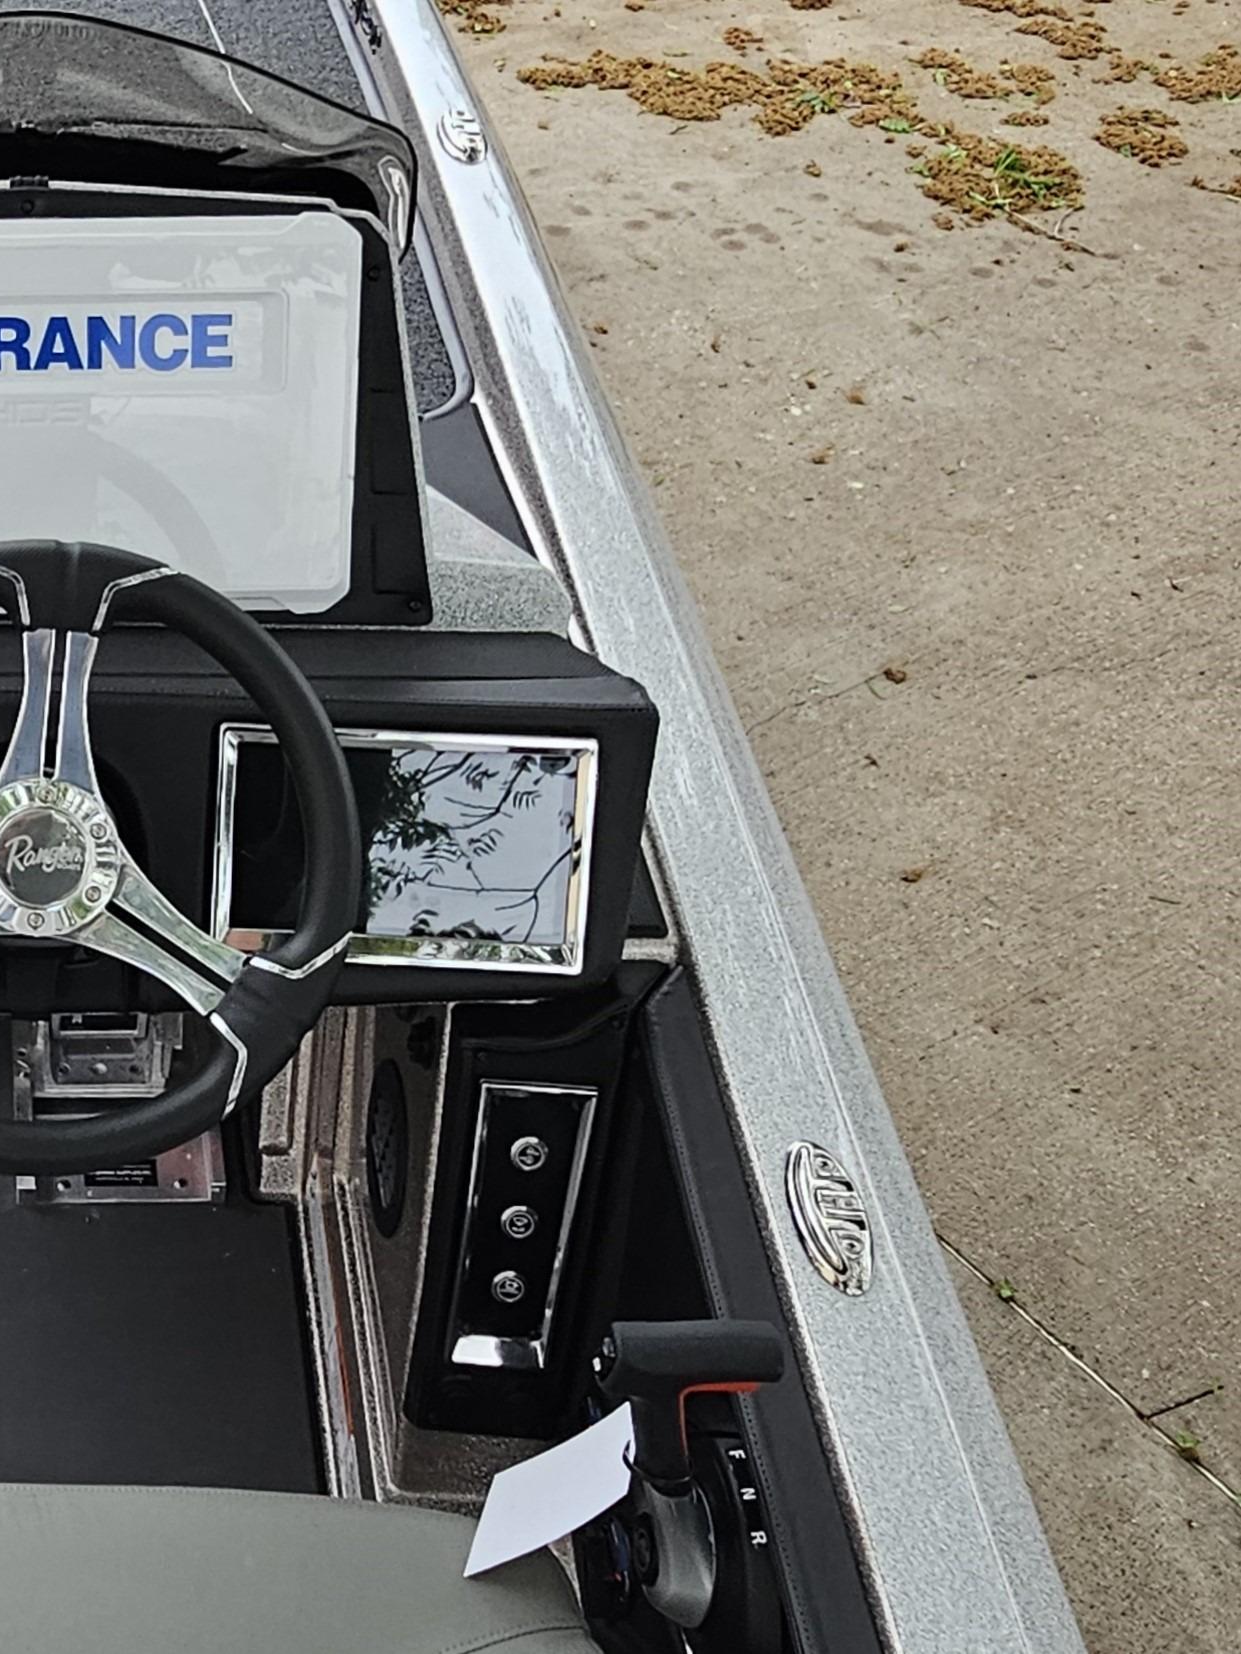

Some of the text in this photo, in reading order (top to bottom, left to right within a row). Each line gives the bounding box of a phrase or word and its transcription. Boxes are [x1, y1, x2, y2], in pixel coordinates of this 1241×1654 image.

[3, 834, 84, 874] Ranger
[728, 1449, 746, 1460] F
[740, 1488, 757, 1501] N
[750, 1531, 768, 1547] R
